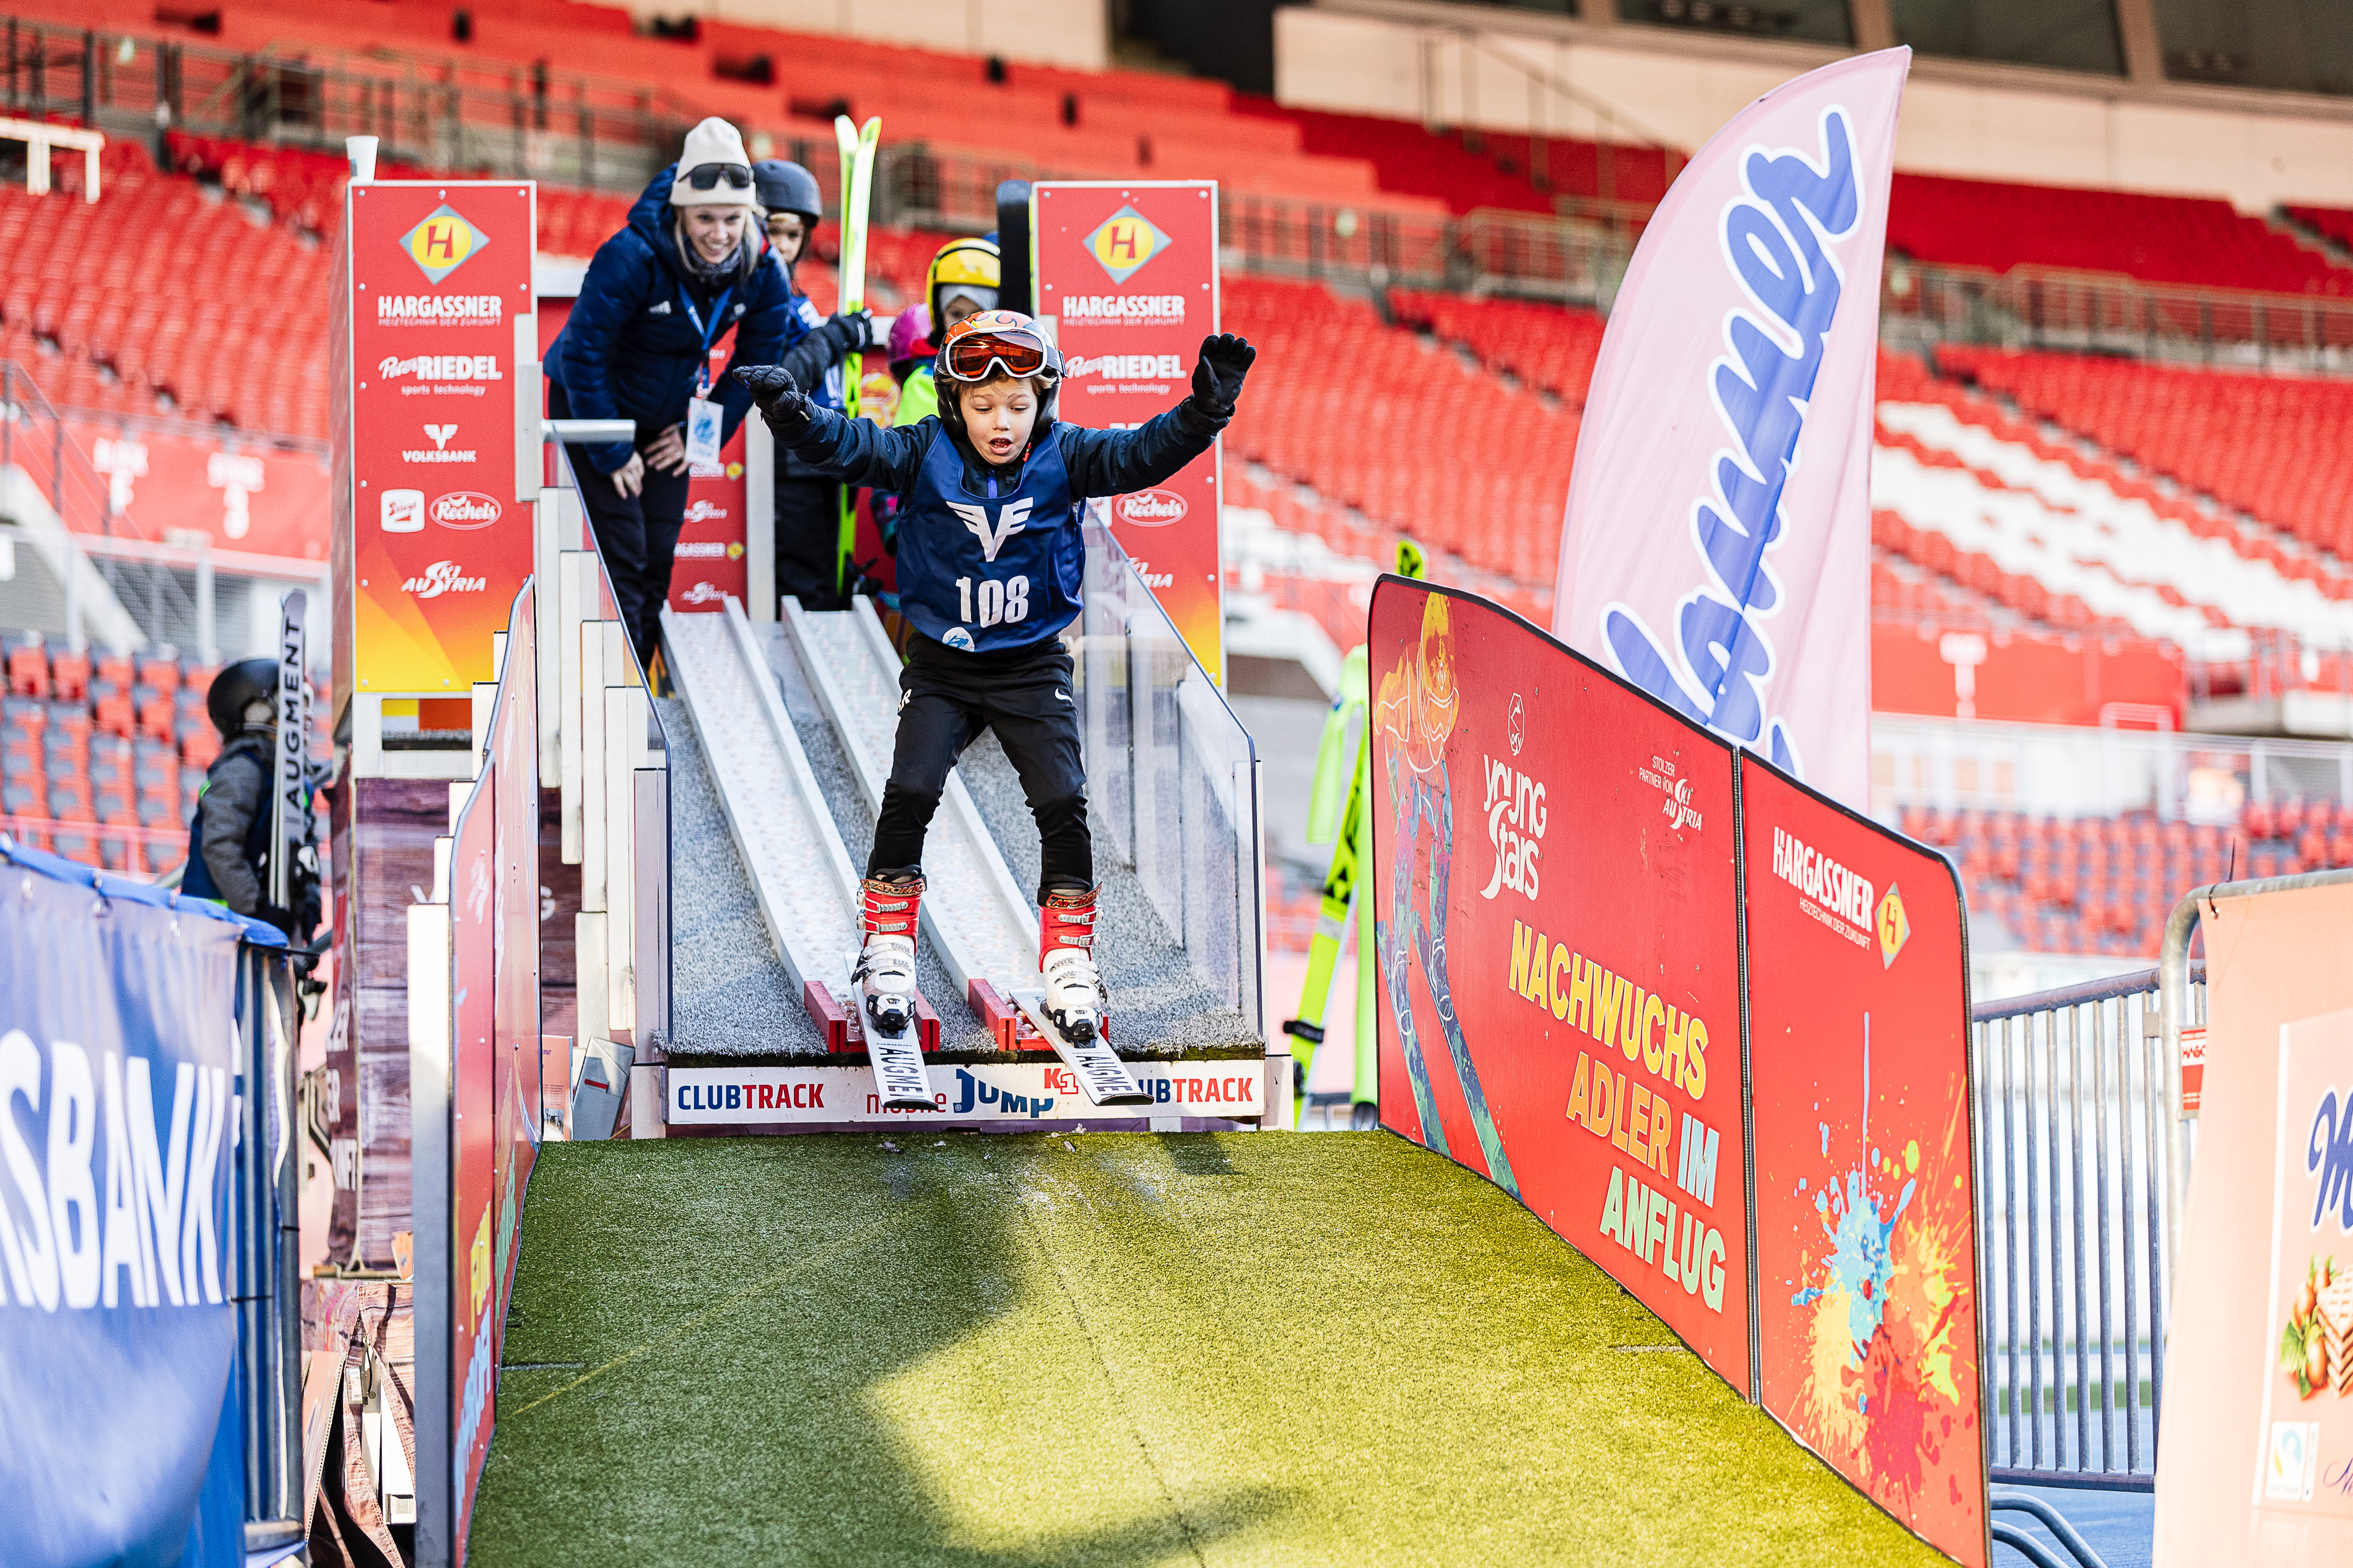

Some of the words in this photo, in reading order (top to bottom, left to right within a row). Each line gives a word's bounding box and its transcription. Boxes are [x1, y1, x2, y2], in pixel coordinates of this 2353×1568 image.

[378, 295, 502, 318] HARGASSNER
[1063, 295, 1185, 318] HARGASSNER
[416, 355, 503, 380] RIEDEL
[1102, 355, 1186, 379] RIEDEL
[401, 384, 430, 397] sports
[433, 384, 486, 397] technology
[1601, 104, 1864, 777] anner
[402, 450, 477, 463] VOLKSBANK
[401, 577, 487, 598] AUSTRIA
[955, 575, 1029, 628] 108
[284, 617, 302, 810] AUGMENT
[1652, 755, 1675, 777] STOLZER
[1639, 767, 1661, 789] PARTNER
[1663, 776, 1673, 795] VON
[1662, 798, 1702, 831] AUSTRIA
[871, 881, 925, 894] ATOMIC
[1773, 826, 1874, 932] HARGASSNER
[1799, 897, 1833, 929] HEIZTECHNIK
[1832, 917, 1845, 935] DER
[1845, 925, 1871, 951] ZUKUNFT
[1508, 918, 1709, 1101] NACHWUCHS
[678, 1083, 824, 1110] CLUBTRACK
[1138, 1078, 1253, 1104] UBTRACK
[1565, 1051, 1672, 1179] ADLER
[1677, 1111, 1720, 1208] IM
[0, 1029, 224, 1314] SBANK
[1599, 1165, 1726, 1314] ANFLUG
